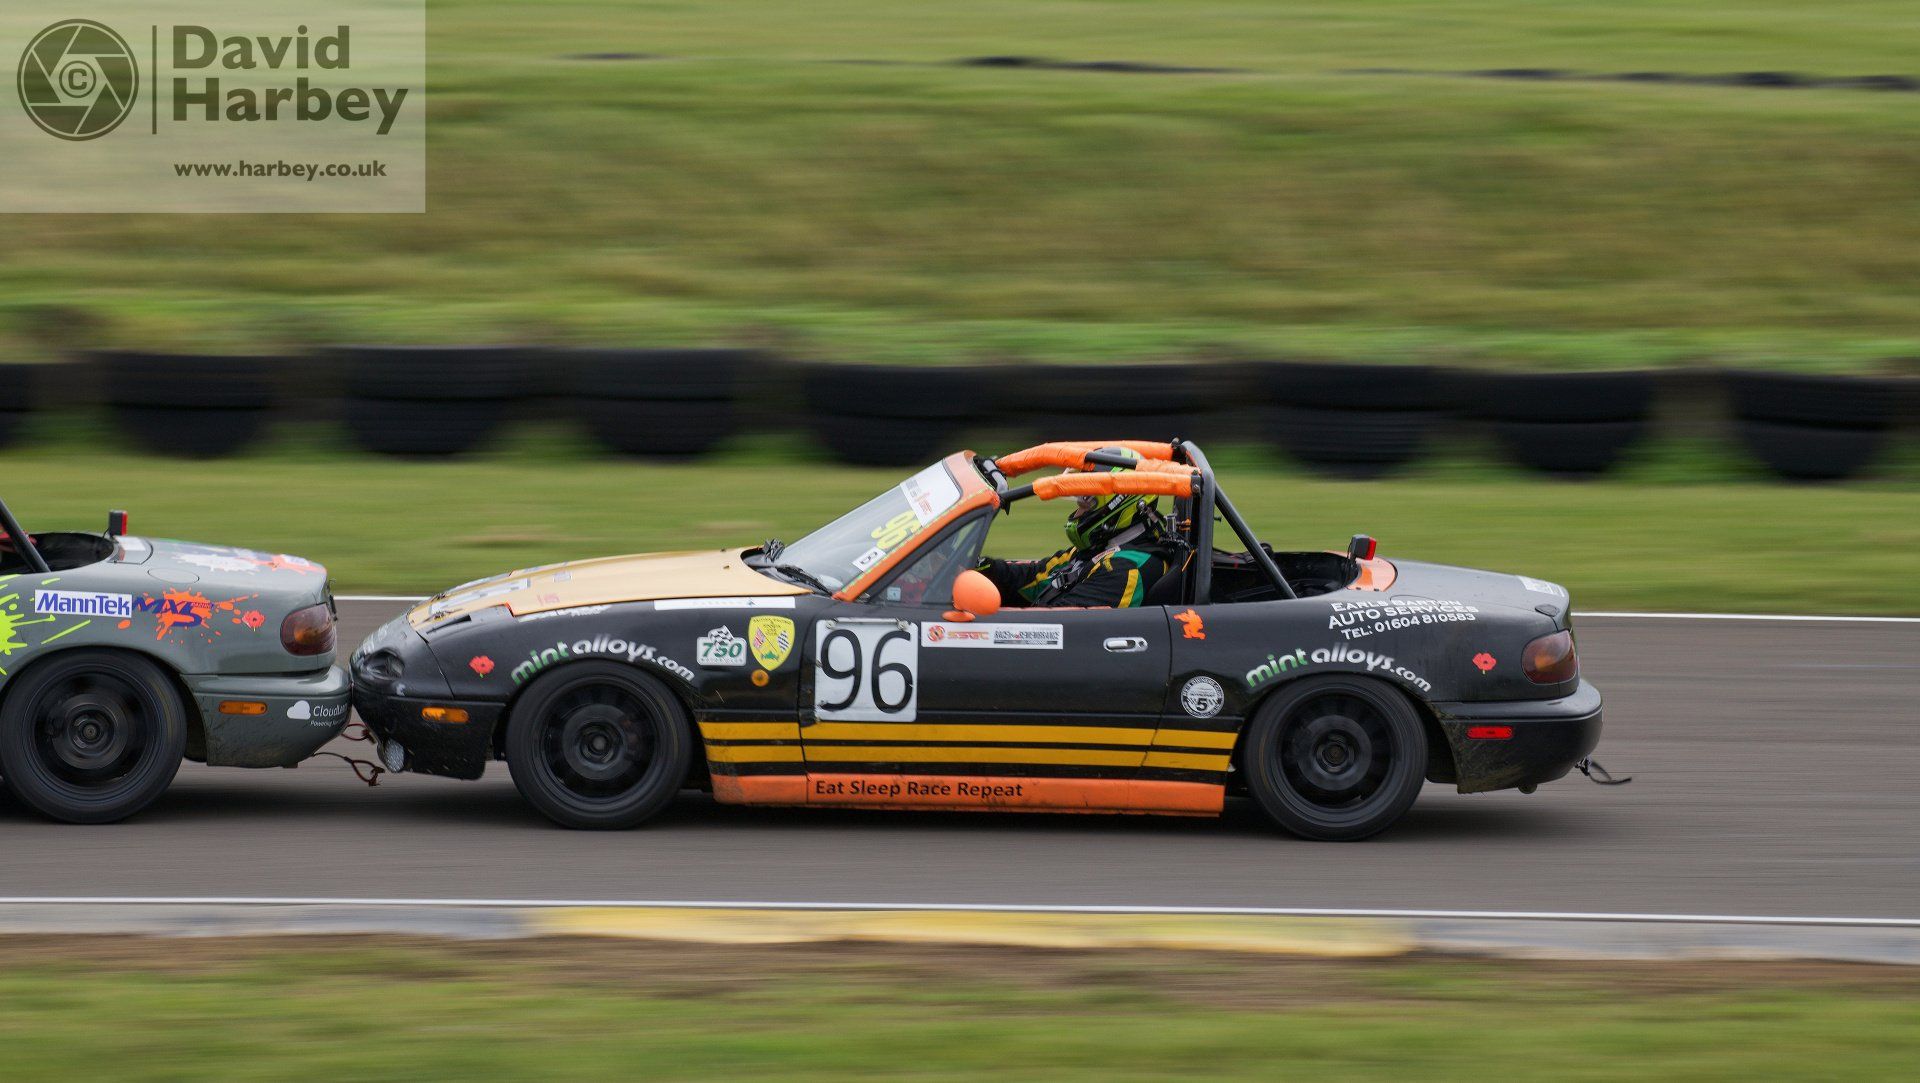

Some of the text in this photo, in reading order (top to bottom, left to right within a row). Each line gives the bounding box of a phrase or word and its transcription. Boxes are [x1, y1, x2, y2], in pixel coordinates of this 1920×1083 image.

[871, 510, 922, 550] 96
[37, 592, 130, 616] MannTek
[1330, 600, 1389, 612] EARLS
[1328, 605, 1480, 630] AUTO SERVICES
[1341, 613, 1476, 640] TEL: 01604 810583
[510, 634, 695, 686] mint alloys.com
[702, 642, 743, 658] 750
[819, 629, 913, 713] 96
[1245, 648, 1308, 688] mint
[1311, 642, 1432, 692] alloys.com
[816, 780, 1023, 799] Eat Sleep Race Repeat
